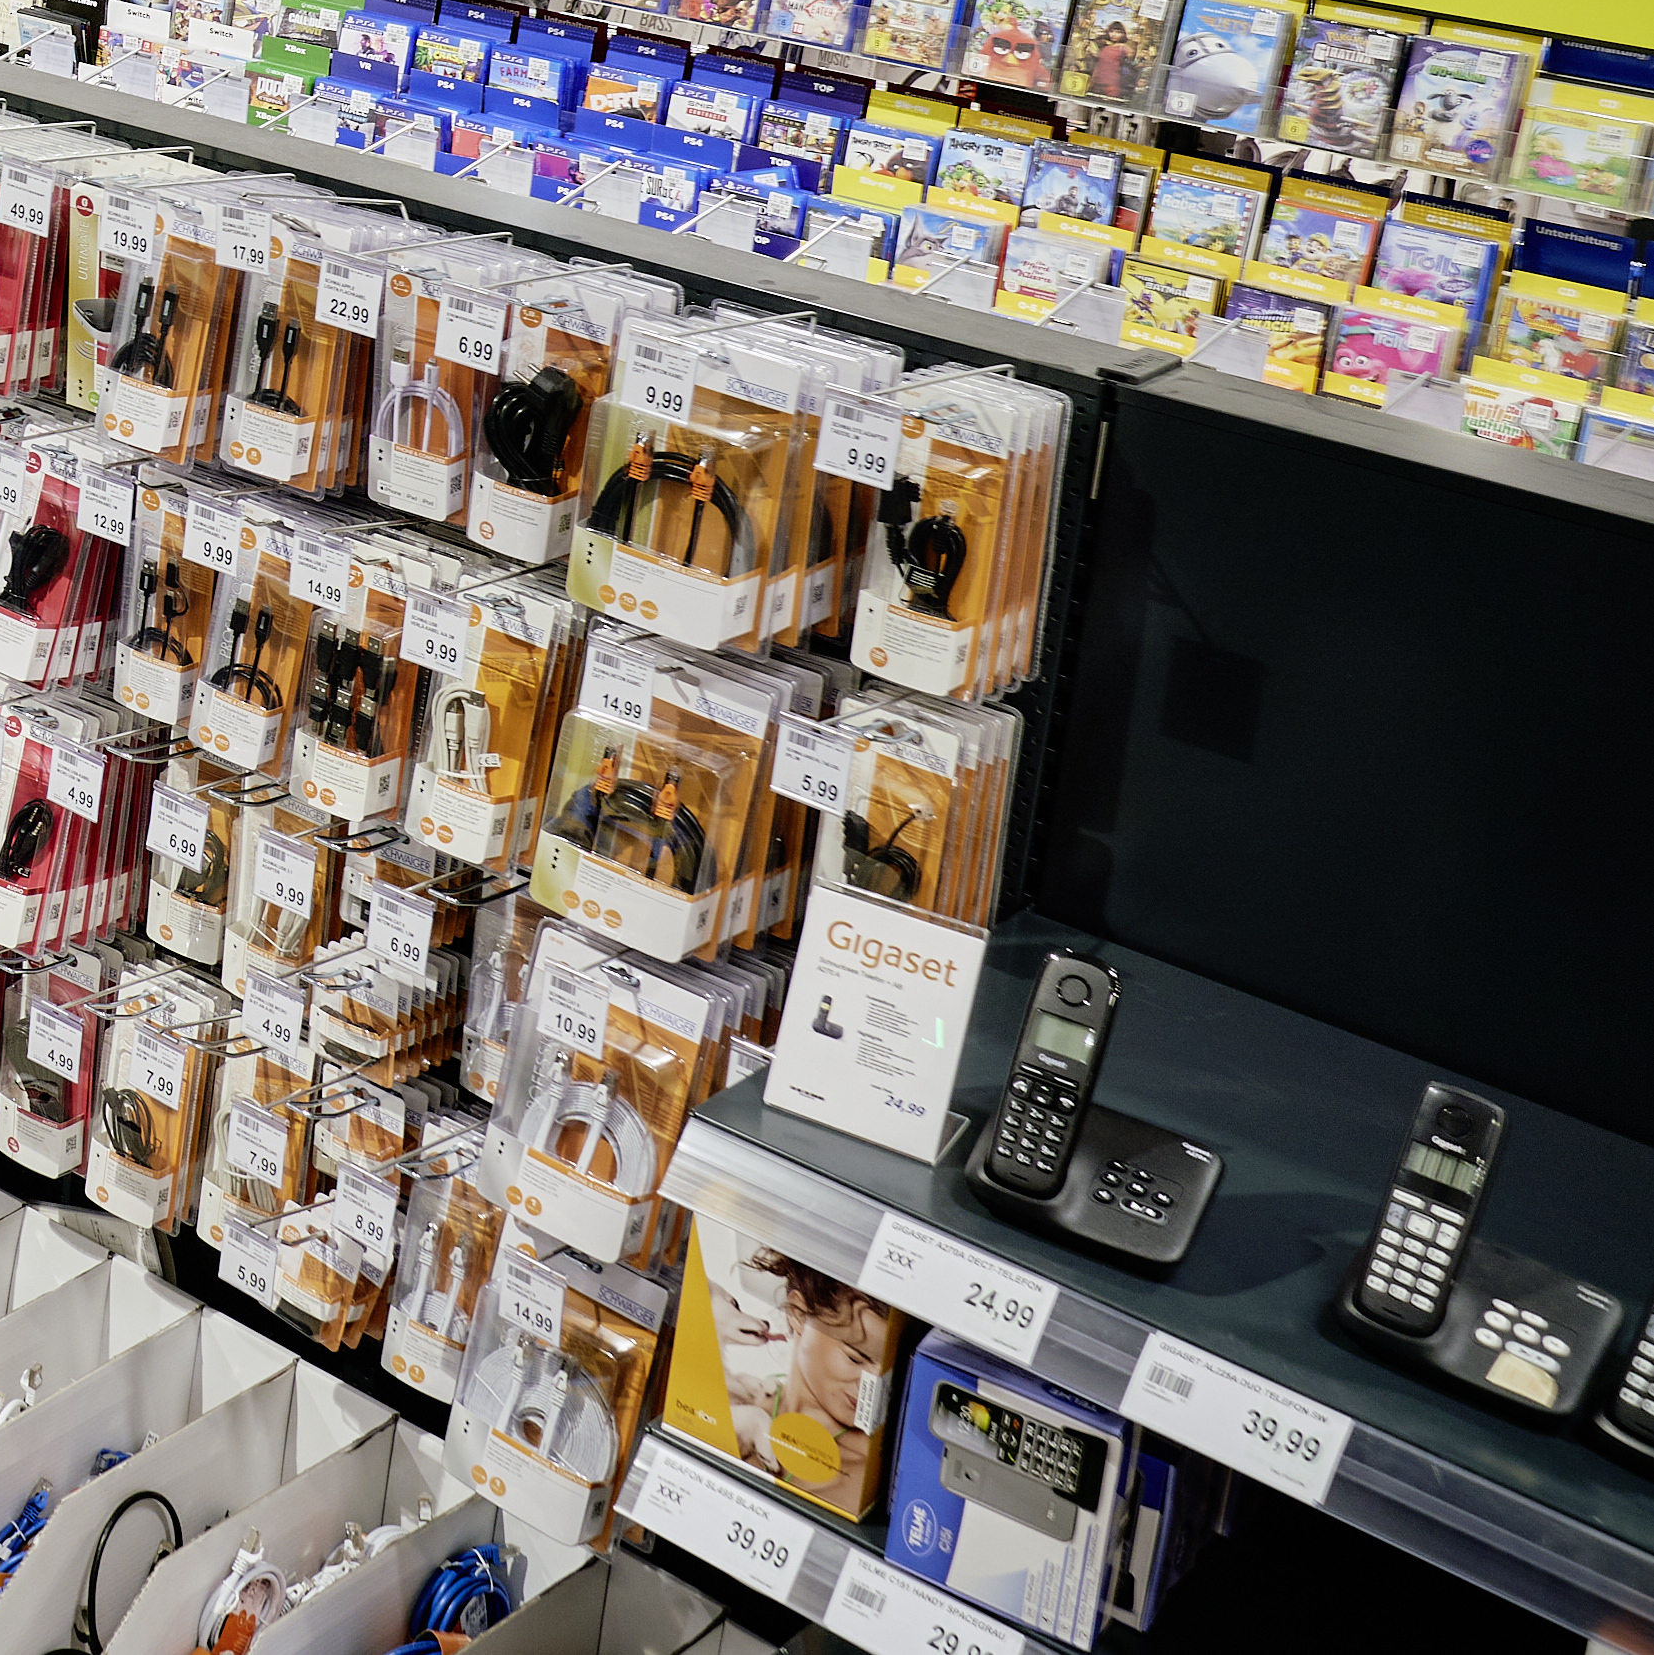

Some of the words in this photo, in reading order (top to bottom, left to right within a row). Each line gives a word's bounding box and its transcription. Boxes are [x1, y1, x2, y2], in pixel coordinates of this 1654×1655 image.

[467, 9, 486, 21] PS4
[209, 26, 234, 39] Switch
[284, 43, 307, 56] XBox
[512, 97, 532, 109] PS4
[604, 117, 625, 130] PS4
[769, 156, 792, 168] TOP
[10, 202, 44, 225] 49,99
[654, 209, 676, 223] PS4
[113, 230, 147, 253] 19,99
[1535, 225, 1623, 252] Unterhaltung
[77, 222, 91, 282] ULTIMATE
[232, 244, 264, 265] 17,99
[329, 298, 369, 324] 22,99
[459, 336, 493, 361] 6,99
[645, 385, 683, 413] 9,99
[726, 379, 789, 406] SCHWAIGER
[936, 425, 1002, 451] SCHWAIGER
[847, 448, 886, 474] 9,99
[94, 513, 124, 535] 12,99
[203, 541, 233, 566] 9,99
[308, 579, 341, 603] 14,99
[425, 639, 457, 663] 9,99
[602, 693, 642, 719] 14,99
[696, 698, 757, 730] SCHWAIGER
[67, 786, 94, 809] 4,99
[801, 774, 838, 802] 5,99
[169, 833, 197, 858] 6,99
[276, 882, 304, 906] 9,99
[390, 937, 420, 962] 6,99
[826, 919, 959, 989] Gigaset
[262, 1018, 291, 1043] 4,99
[555, 1013, 596, 1044] 10,99
[636, 1000, 696, 1036] SCHWAIGER
[146, 1069, 174, 1096] 7,99
[884, 1093, 926, 1118] 24,99
[249, 1150, 277, 1177] 7,99
[355, 1214, 384, 1242] 8,99
[890, 1221, 936, 1250] GIGASET
[237, 1265, 266, 1293] 5,99
[514, 1302, 553, 1333] 14,99
[598, 1286, 656, 1326] SCHWAIGER
[962, 1281, 1035, 1330] 24,99
[1241, 1407, 1322, 1464] 39,99
[663, 1456, 705, 1485] BEAFON
[735, 1494, 771, 1523] BLACK
[907, 1503, 927, 1548] TELME
[726, 1520, 790, 1570] 39,99
[856, 1558, 890, 1585] TELME
[911, 1586, 946, 1613] HANDY
[944, 1602, 1009, 1643] SPACEGRAU
